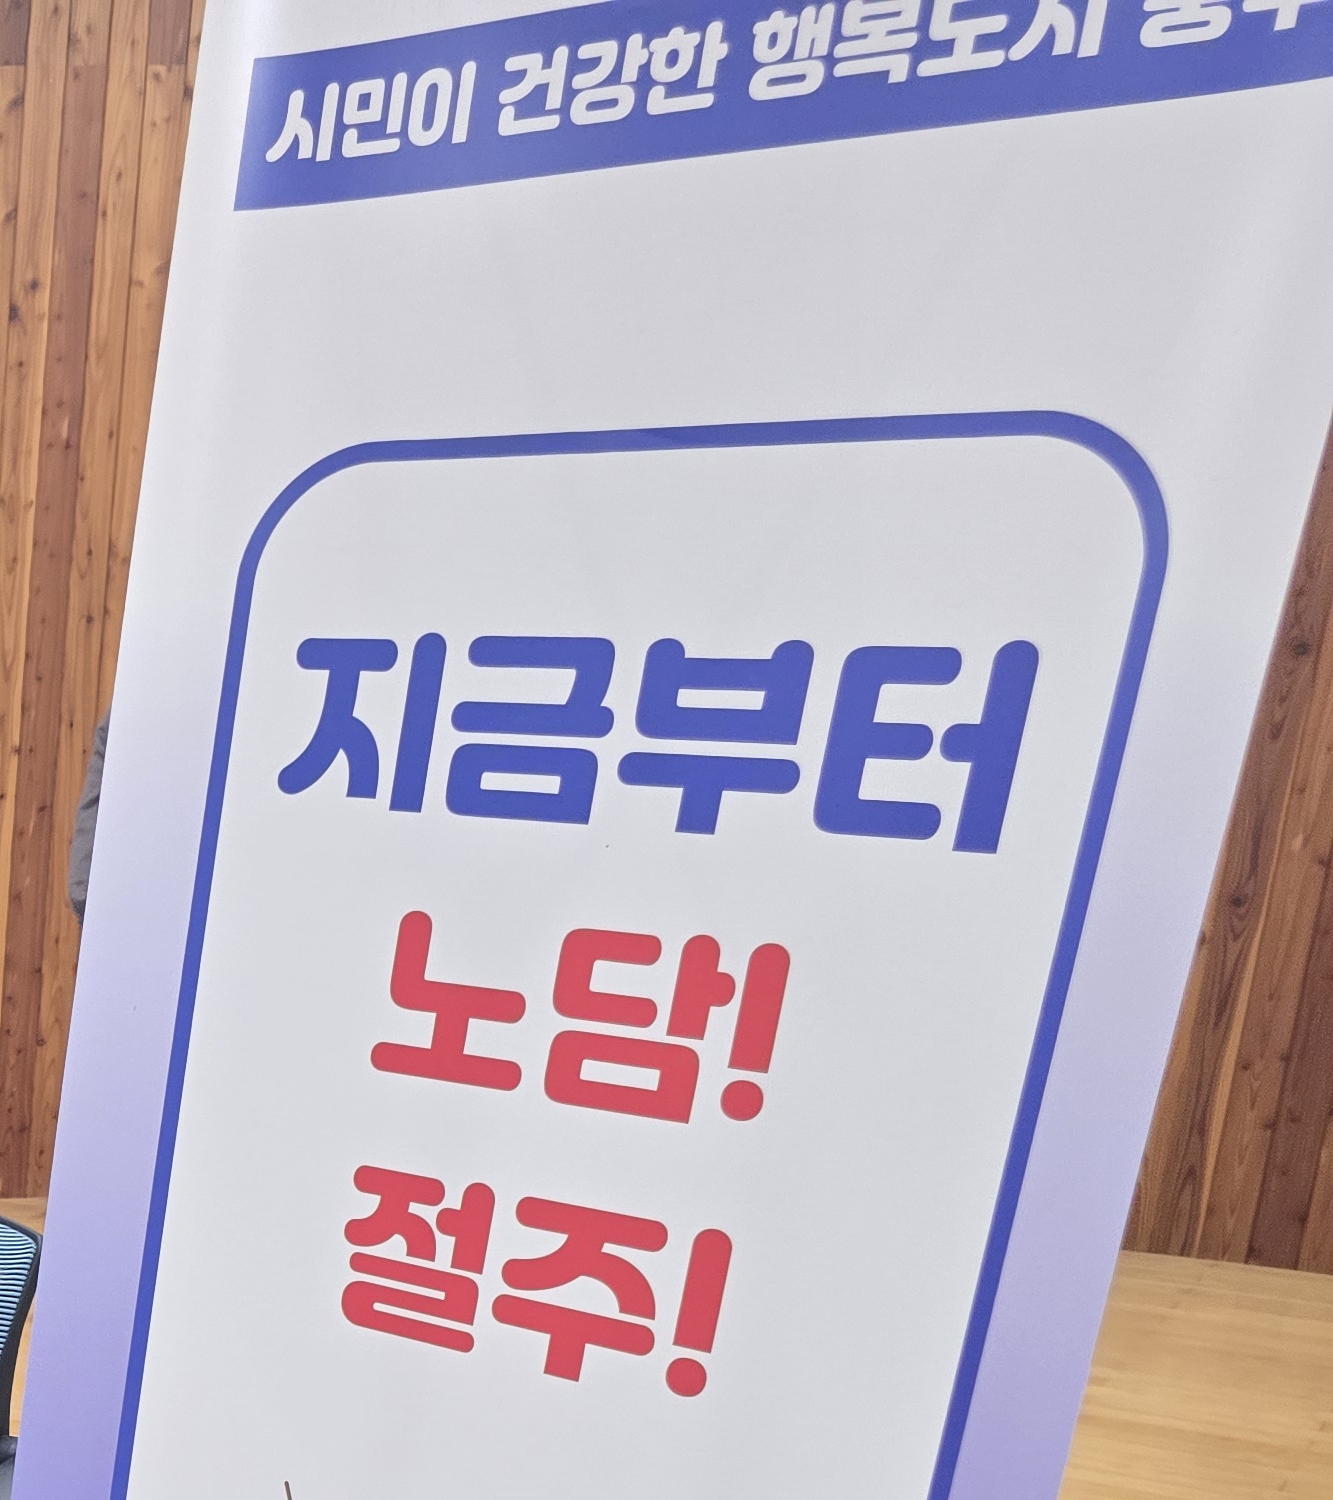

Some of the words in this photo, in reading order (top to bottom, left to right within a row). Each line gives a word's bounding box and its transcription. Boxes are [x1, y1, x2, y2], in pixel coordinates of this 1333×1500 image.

[265, 60, 477, 163] 시민이
[497, 19, 729, 137] 건강한
[276, 631, 1041, 855] 지금부터
[369, 909, 792, 1125] 노담!
[340, 1164, 733, 1398] 절주!
